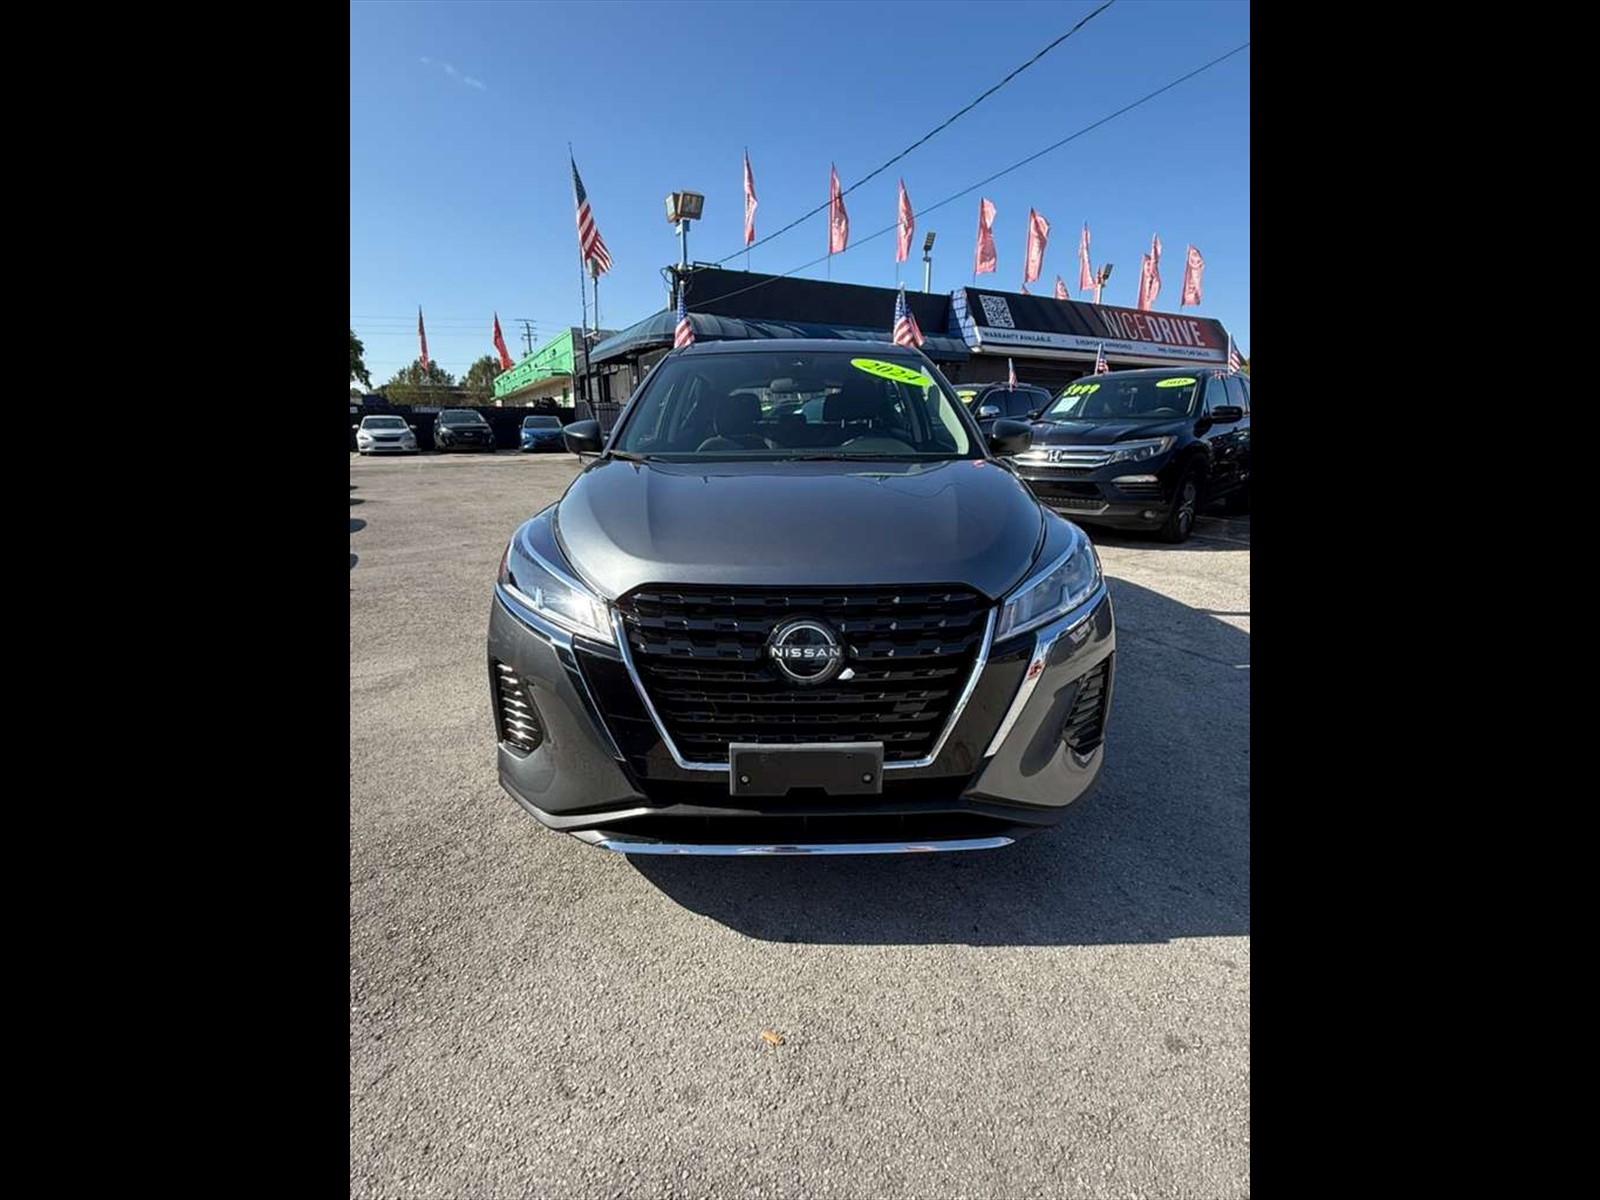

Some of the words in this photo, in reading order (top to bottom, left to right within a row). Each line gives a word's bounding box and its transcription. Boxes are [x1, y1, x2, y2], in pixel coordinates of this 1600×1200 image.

[983, 331, 1018, 341] WARRANTY
[863, 360, 922, 382] 2024
[771, 647, 841, 658] NISSAN
